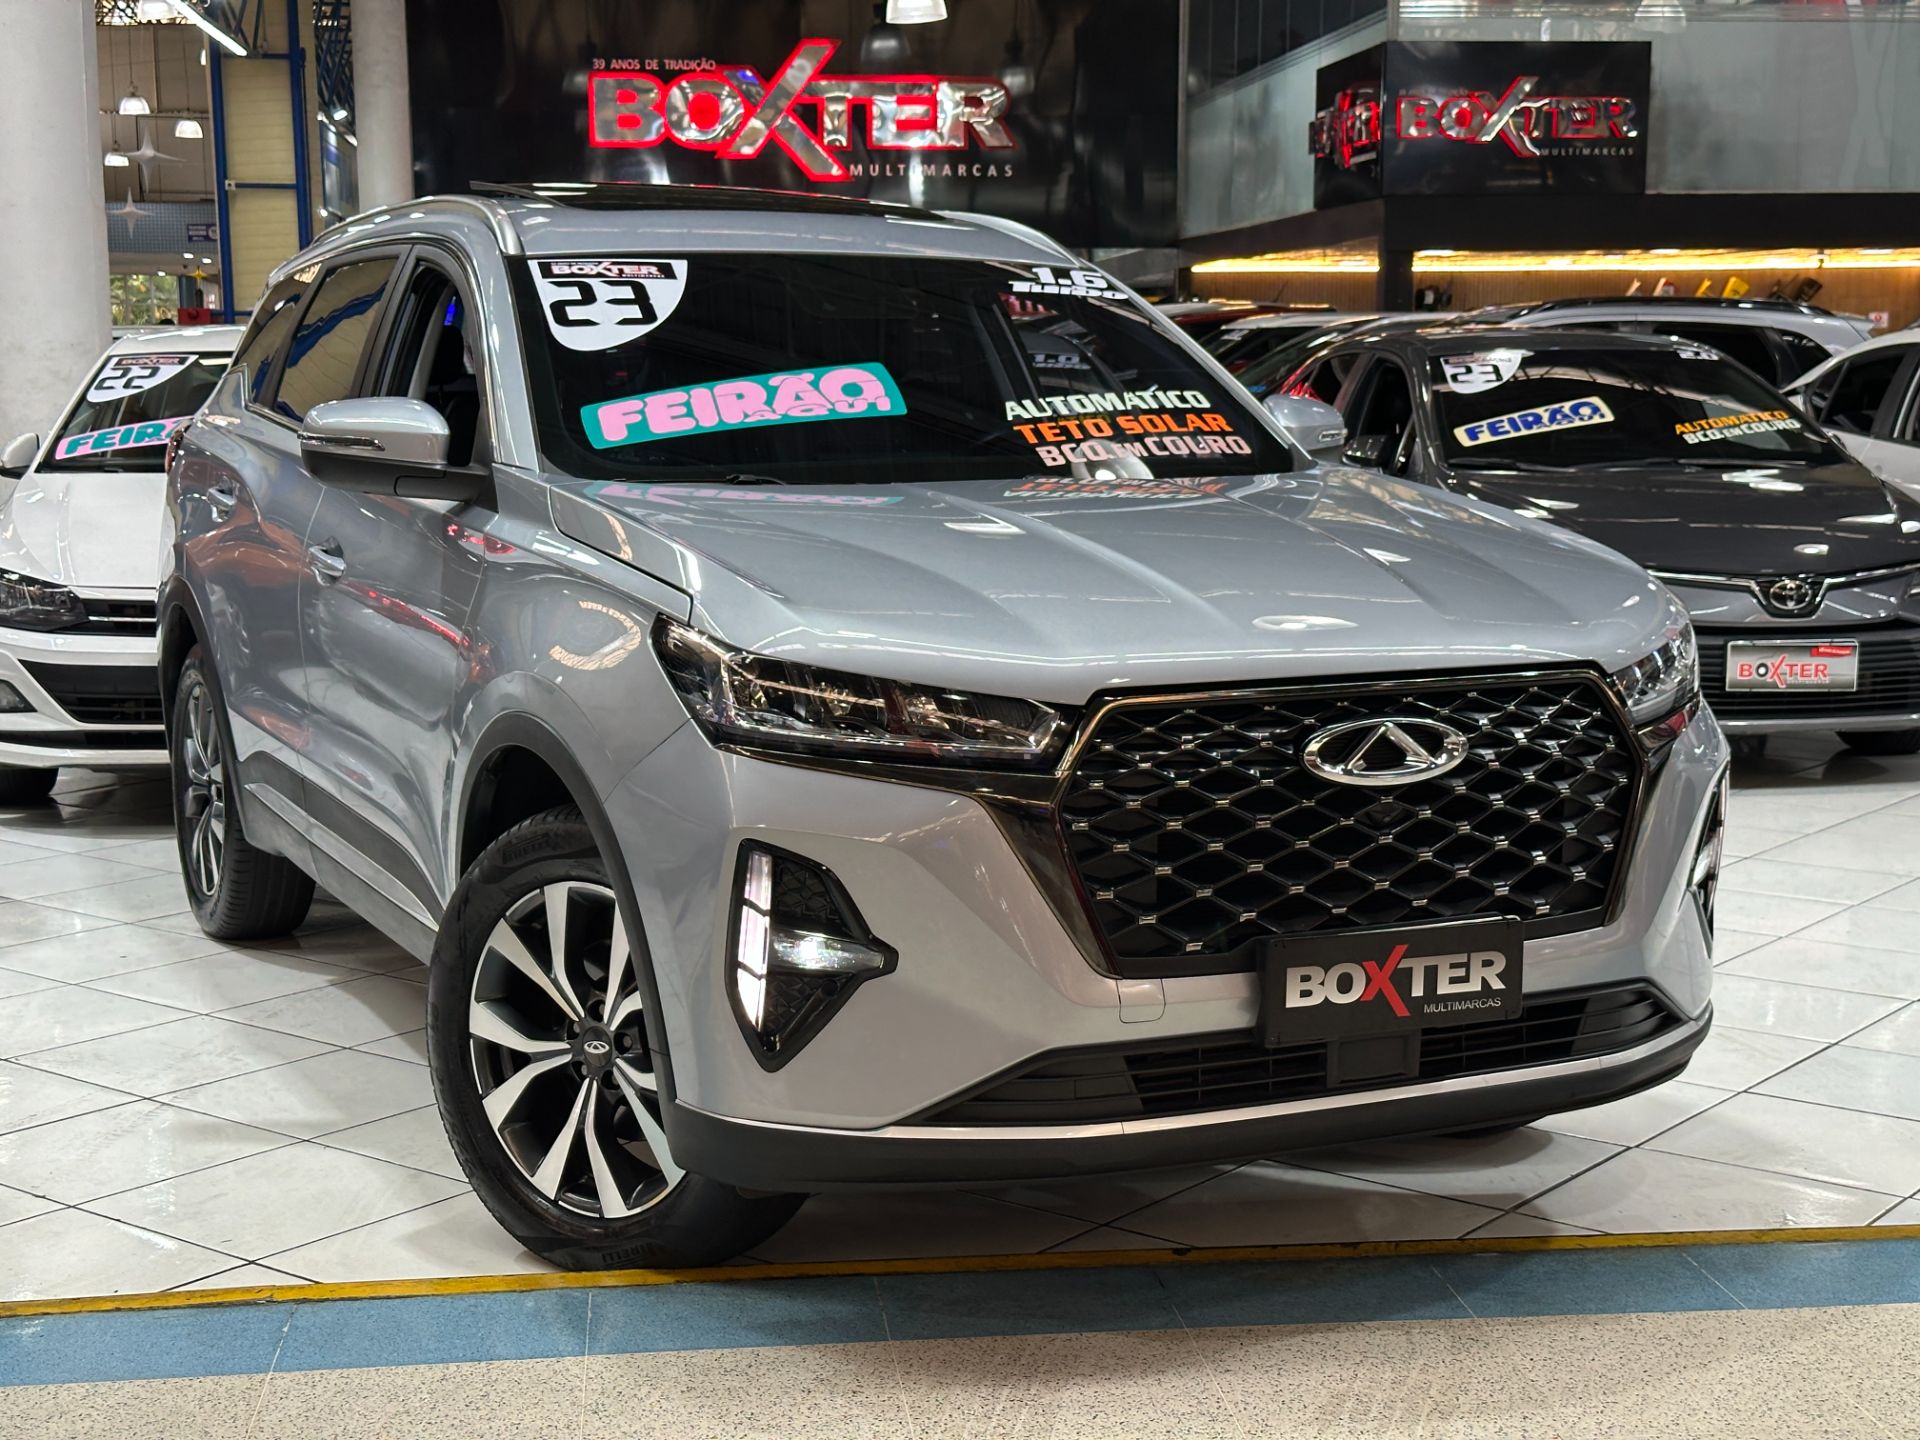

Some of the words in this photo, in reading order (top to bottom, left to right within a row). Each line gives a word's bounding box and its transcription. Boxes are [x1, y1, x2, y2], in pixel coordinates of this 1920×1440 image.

[592, 58, 606, 70] 39
[610, 59, 641, 70] ANOS
[645, 59, 659, 70] DE
[664, 57, 716, 72] TRADIÇÃO
[588, 38, 1019, 182] BOXTER
[1397, 76, 1637, 158] BOXTER
[551, 261, 661, 277] BOXTER
[1032, 267, 1108, 289] 1.6
[547, 279, 658, 328] 23
[121, 356, 181, 366] BOXTER
[1449, 364, 1503, 383] 23
[94, 366, 161, 391] 22
[597, 368, 886, 442] FEIRÃO
[64, 418, 180, 455] FEIR
[1012, 418, 1114, 444] TETO
[1116, 413, 1234, 435] SOLAR
[1740, 418, 1802, 434] COURO
[1143, 435, 1252, 457] COURO
[1737, 653, 1830, 689] BOXTER
[1286, 944, 1507, 1017] BOXTER
[1424, 997, 1502, 1013] MULTIMARCAS
